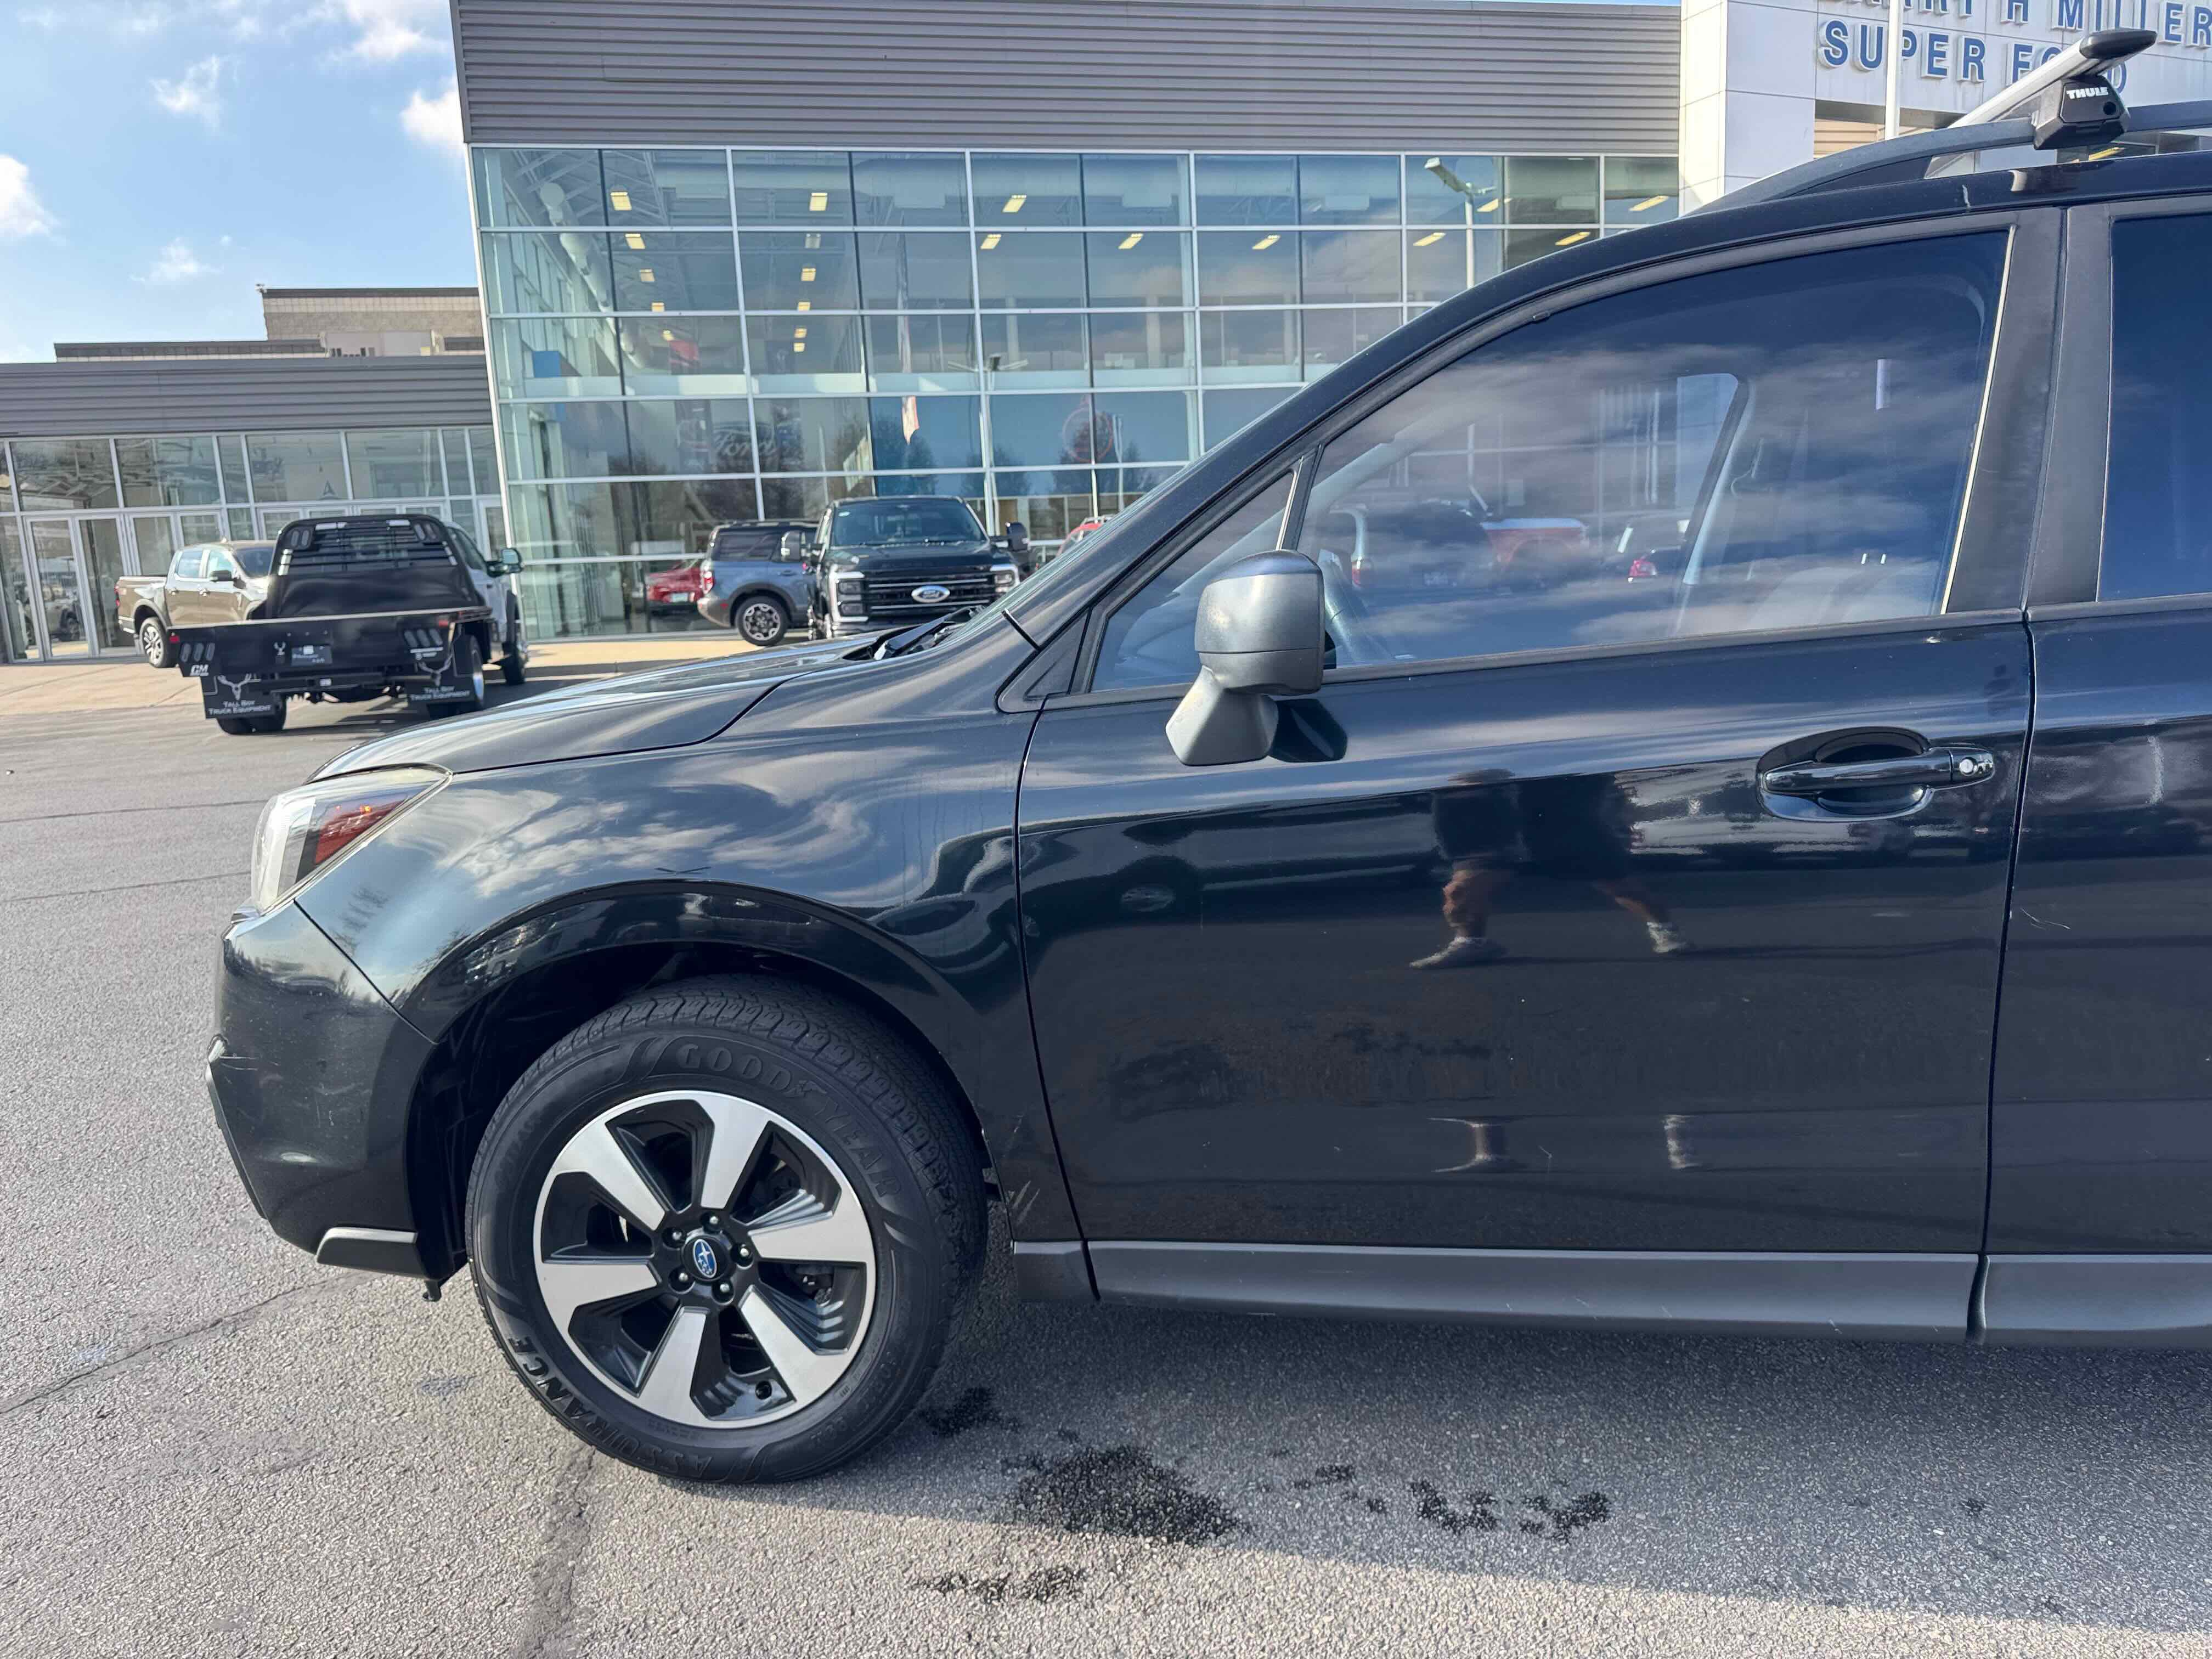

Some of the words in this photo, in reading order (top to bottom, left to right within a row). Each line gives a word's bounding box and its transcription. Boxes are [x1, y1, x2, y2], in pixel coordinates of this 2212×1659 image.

[1820, 19, 1986, 82] SUPER
[2012, 43, 2128, 94] FD
[2066, 87, 2109, 99] THULE
[675, 1043, 901, 1198] GOODYEAR
[507, 1336, 712, 1479] ASSURANCE
